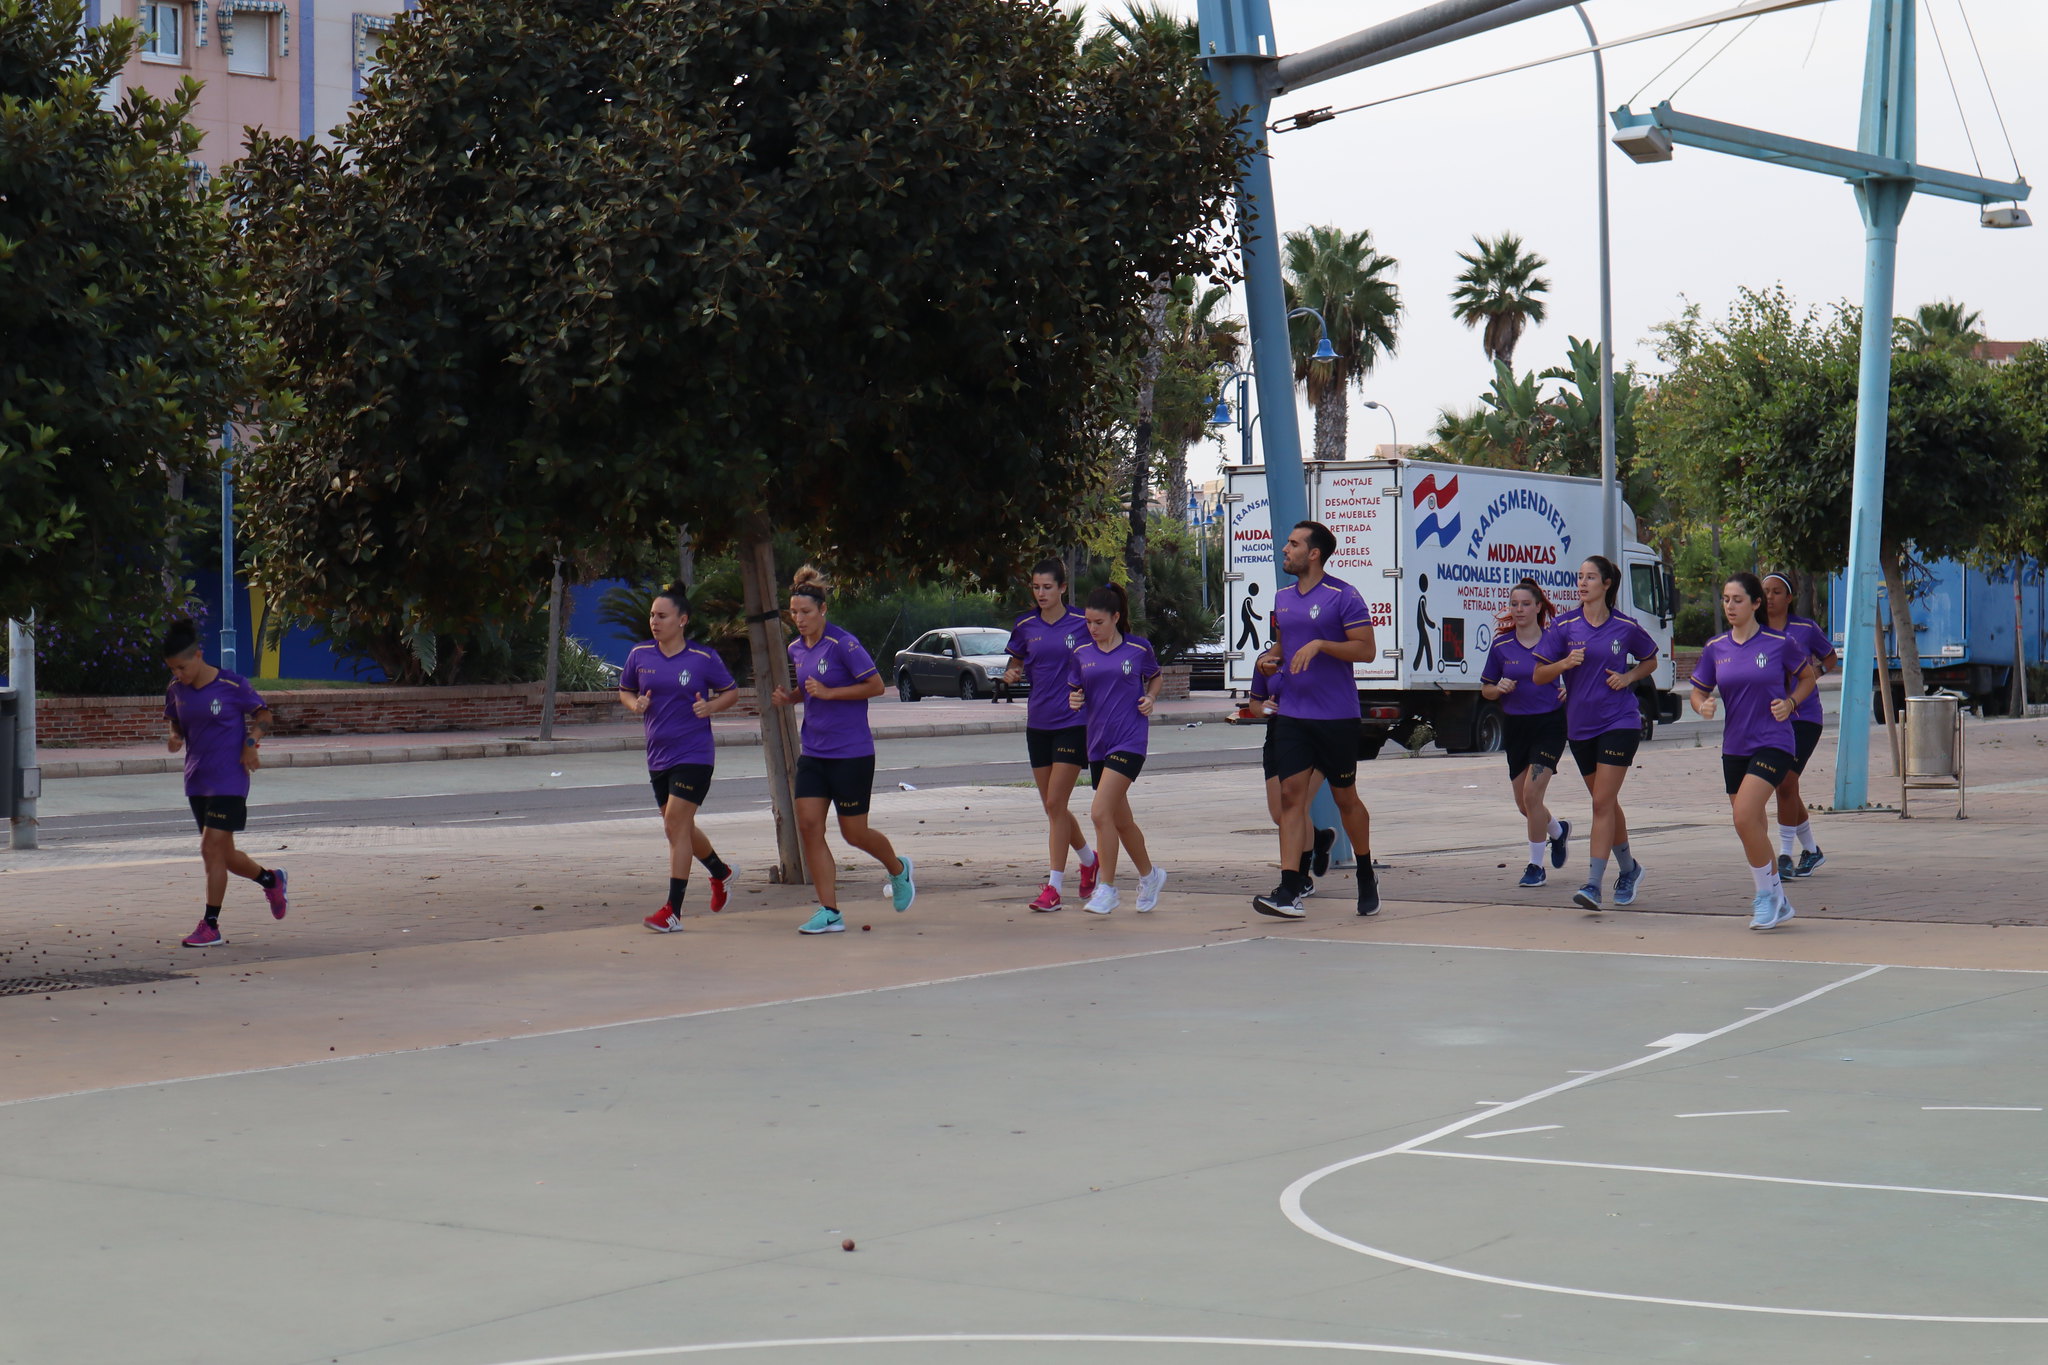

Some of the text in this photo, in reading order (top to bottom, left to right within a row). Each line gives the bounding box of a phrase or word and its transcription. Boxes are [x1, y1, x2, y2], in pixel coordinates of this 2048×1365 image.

[1332, 477, 1373, 487] MONTAJE
[1325, 497, 1381, 507] DESMONTAJE
[1325, 510, 1377, 520] DE MUEBLES
[1330, 524, 1372, 533] RETIRADA
[1467, 489, 1572, 559] TRANSMENDIETA
[1234, 529, 1273, 541] MUDA
[1345, 536, 1356, 544] DE
[1242, 543, 1274, 552] NACION
[1332, 549, 1370, 557] MUEBLES
[1487, 543, 1557, 565] MUDANZAS
[1234, 555, 1274, 564] INTERNAC
[1330, 559, 1373, 568] Y OFICINA
[1437, 563, 1579, 588] NACIONALES E INTERNACION
[1457, 586, 1490, 598] MONTAJE
[1491, 587, 1496, 598] Y
[1552, 590, 1580, 601] MUEBLES
[1370, 602, 1392, 614] 328
[1463, 599, 1497, 612] RETIRADA
[1498, 601, 1507, 611] DE
[1371, 615, 1392, 627] 841
